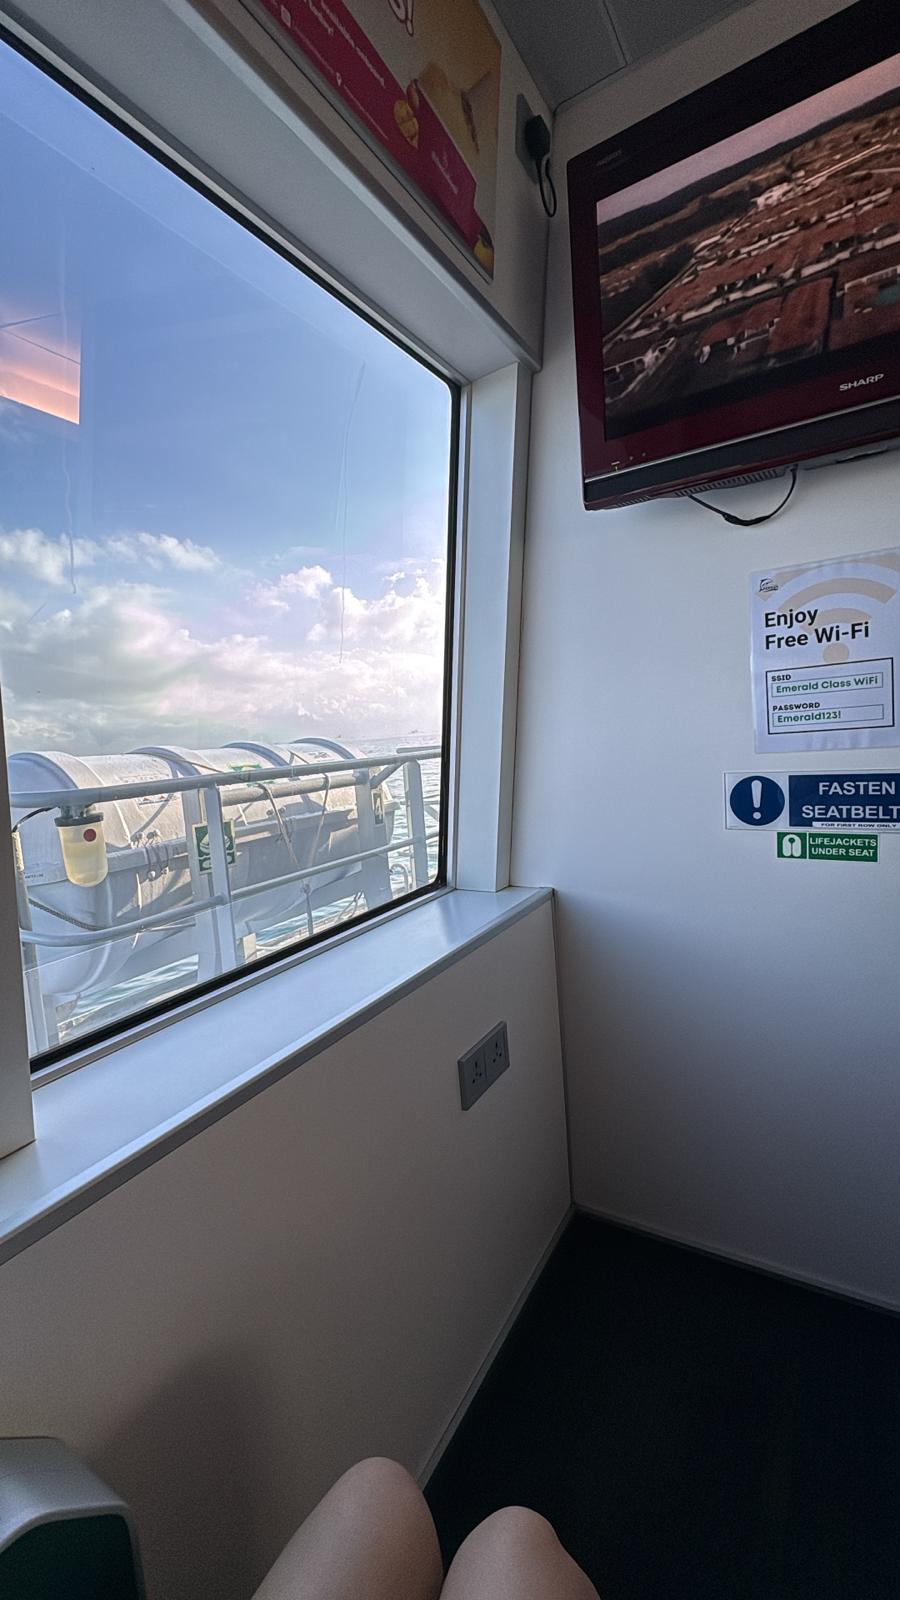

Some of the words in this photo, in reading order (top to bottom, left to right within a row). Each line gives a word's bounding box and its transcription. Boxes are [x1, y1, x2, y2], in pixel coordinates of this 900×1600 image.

[840, 374, 884, 391] SHARP
[764, 608, 818, 630] Enjoy
[764, 632, 809, 650] Free
[815, 621, 870, 645] Wi-Fi
[771, 673, 792, 682] SSID
[776, 680, 819, 694] Emerald
[821, 678, 852, 690] Class
[853, 675, 878, 687] WiFi
[772, 701, 821, 712] PASSWORD
[777, 711, 842, 723] Emerald123!
[819, 781, 896, 796] FASTEN
[810, 837, 877, 847] LIFEJACKETS
[811, 847, 846, 856] UNDER
[848, 849, 875, 857] SEAT
